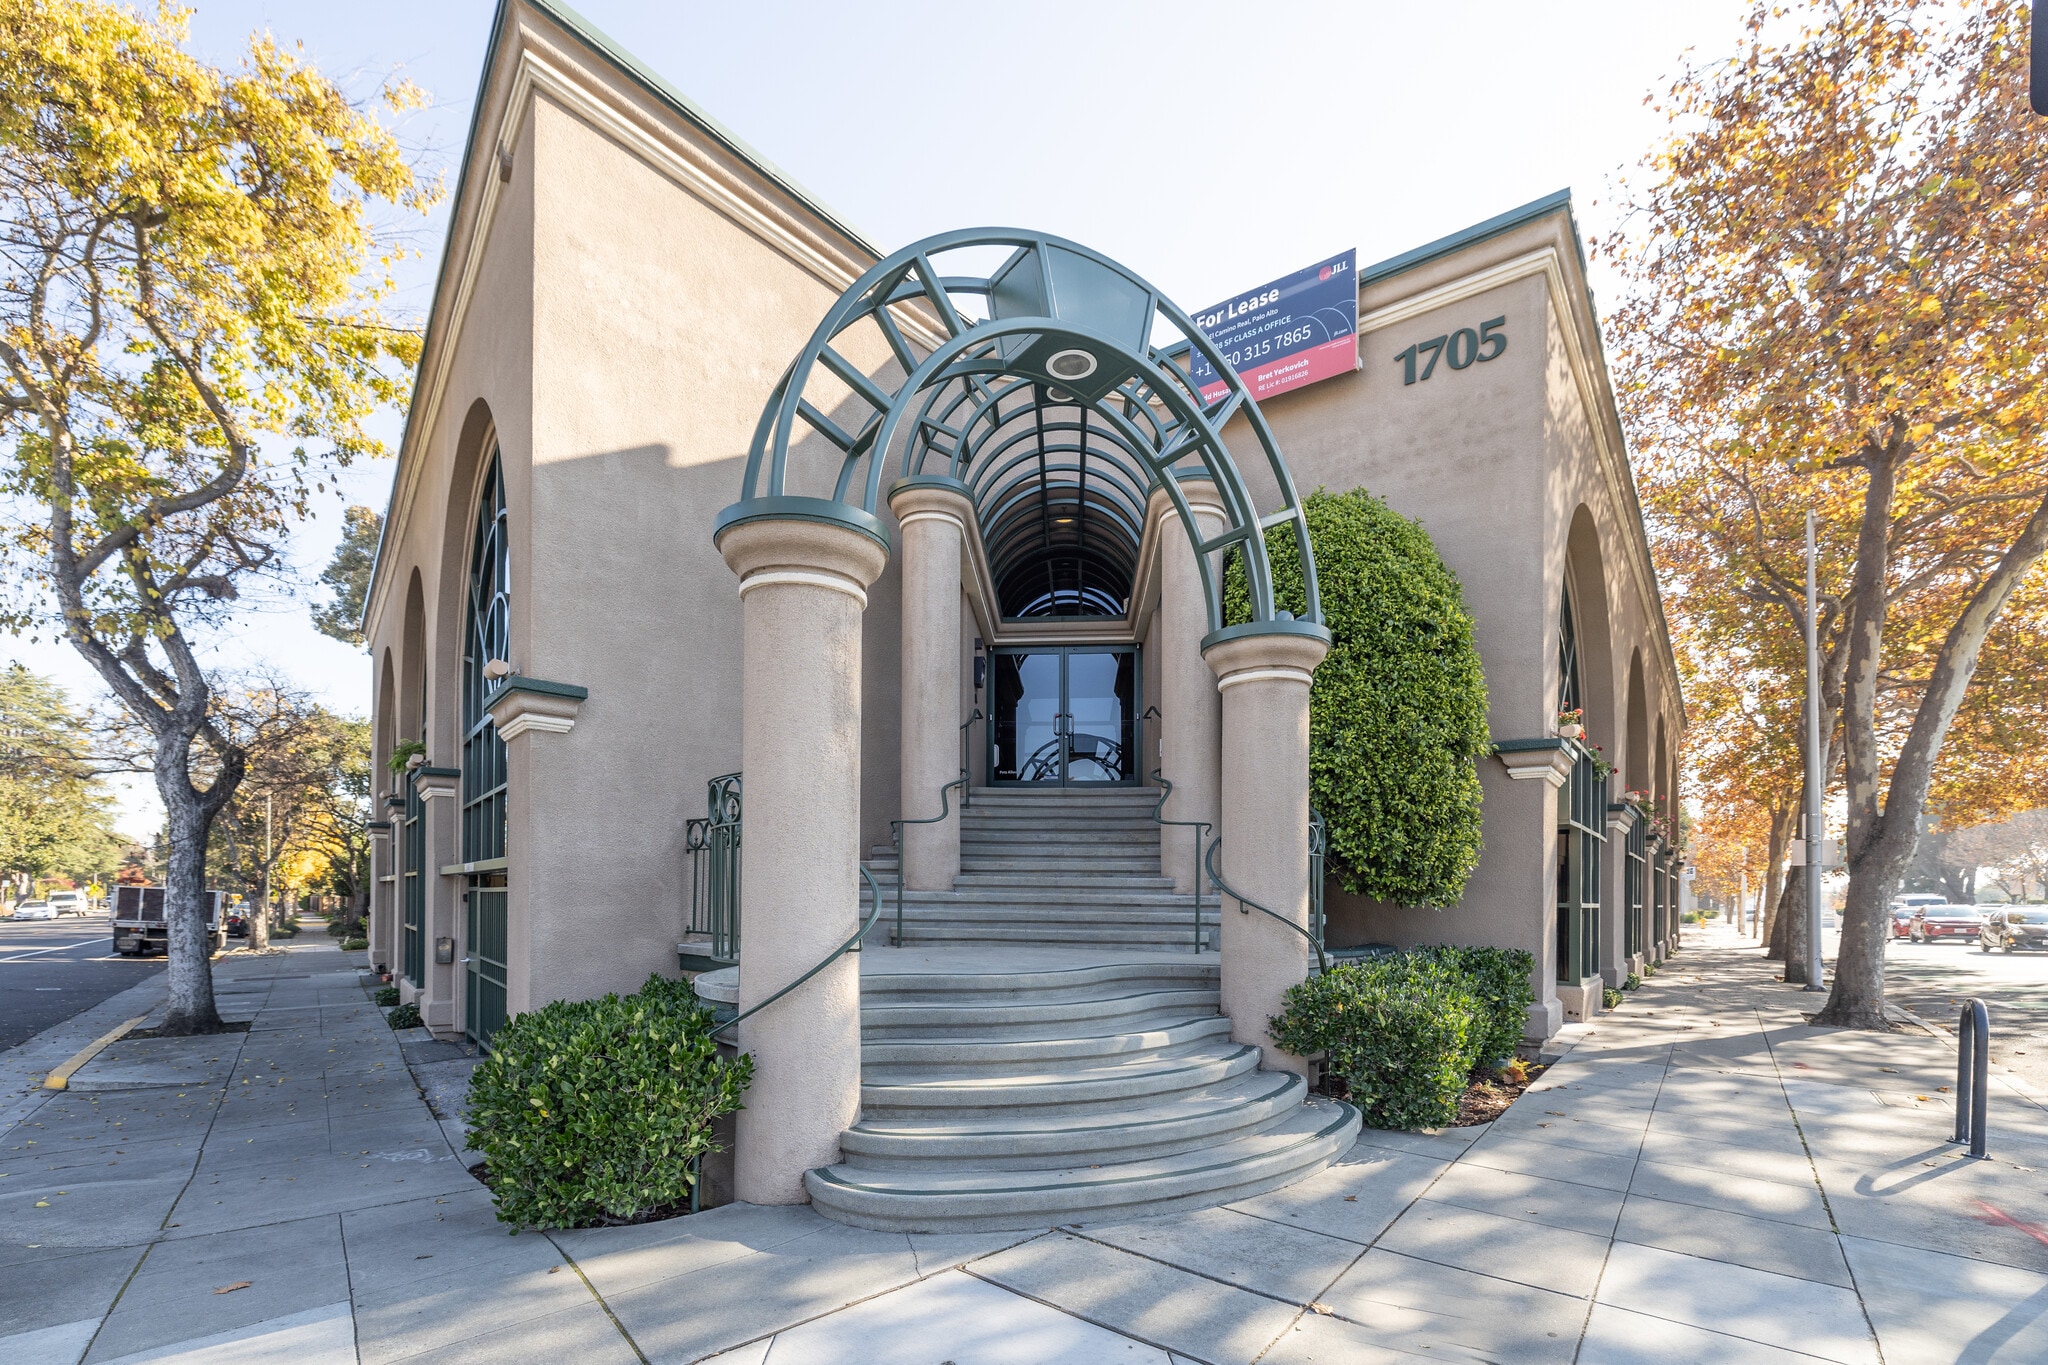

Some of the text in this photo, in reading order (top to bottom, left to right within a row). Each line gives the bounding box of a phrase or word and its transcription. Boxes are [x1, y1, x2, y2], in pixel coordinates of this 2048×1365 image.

[1331, 260, 1348, 275] JLL
[1196, 288, 1279, 328] For Lease
[1215, 325, 1236, 337] Camino
[1252, 314, 1265, 323] Palo
[1266, 309, 1278, 318] Alto
[1225, 338, 1232, 347] SF
[1234, 328, 1256, 342] CLASS
[1258, 326, 1263, 334] A
[1264, 315, 1291, 331] OFFICE
[1196, 362, 1212, 376] +1
[1225, 351, 1240, 365] 50
[1244, 340, 1270, 360] 315
[1274, 324, 1311, 350] 7865
[1393, 315, 1507, 386] 1705
[1258, 359, 1308, 382] Bret Yerkovich
